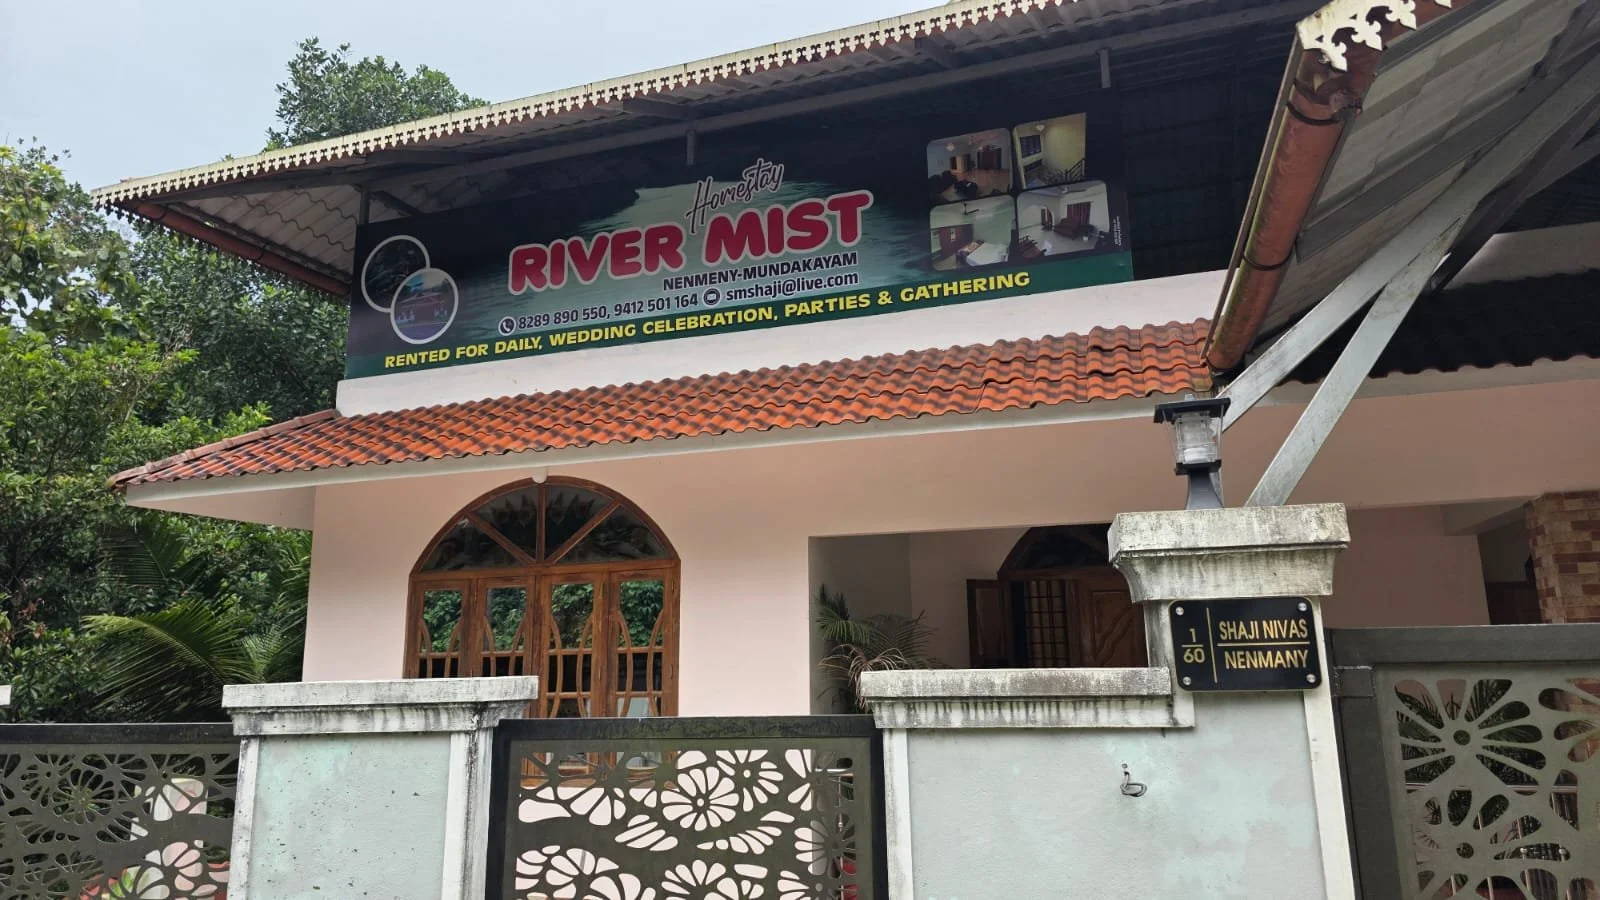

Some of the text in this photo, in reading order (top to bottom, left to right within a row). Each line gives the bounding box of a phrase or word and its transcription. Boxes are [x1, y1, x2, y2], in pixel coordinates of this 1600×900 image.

[686, 158, 784, 234] Homestay
[508, 190, 874, 295] RIVER MIST
[664, 252, 857, 291] NENMENY-MUNDAKAYAM
[384, 271, 1030, 368] RENTED FOR DAILY, WEDDING CELEBRATION, PARTIES & GATHERING
[518, 272, 859, 329] 8289 890 550, 9412 501 164 smshaji@live.com
[1188, 628, 1196, 643] 1
[1219, 618, 1308, 640] SHAJI NIVAS
[1183, 648, 1205, 663] 60
[1224, 649, 1309, 670] NENMANY
